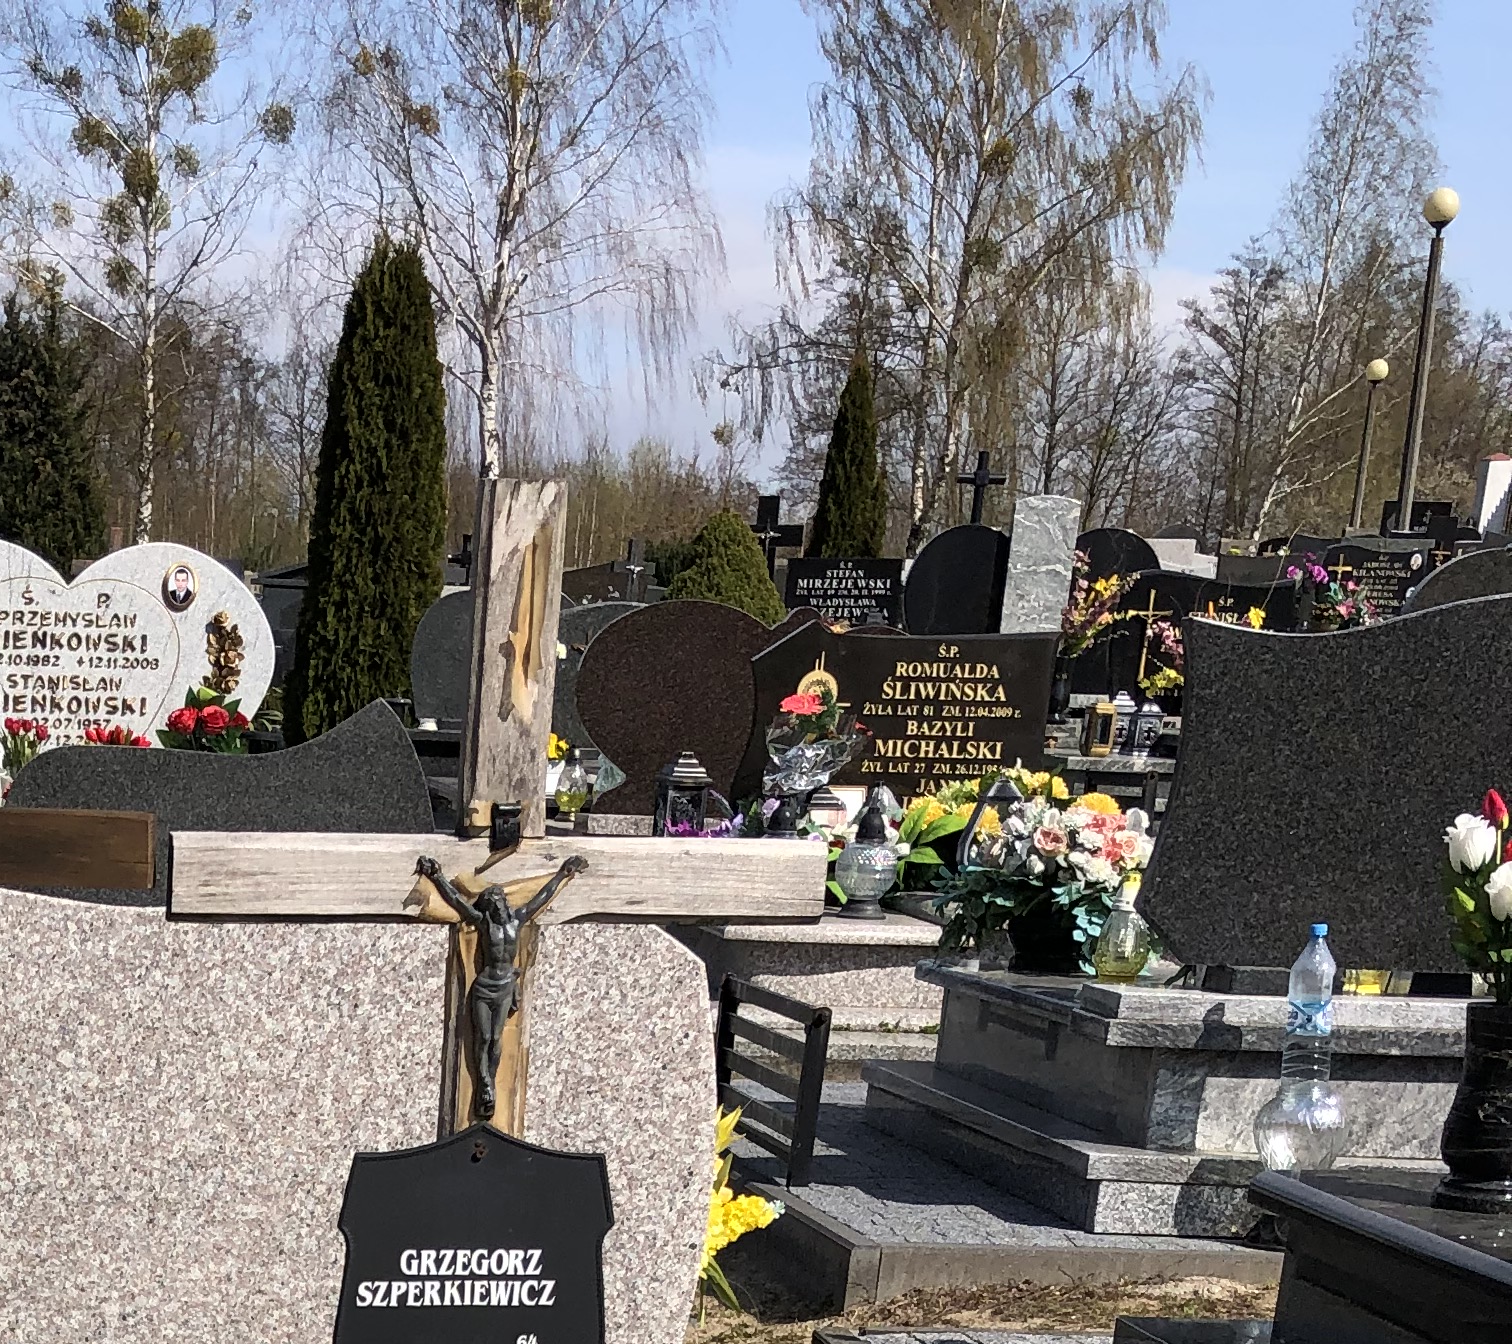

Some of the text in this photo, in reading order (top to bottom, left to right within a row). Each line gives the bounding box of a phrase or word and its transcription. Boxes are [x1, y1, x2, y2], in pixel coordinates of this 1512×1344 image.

[826, 569, 865, 578] STEFAN
[797, 578, 891, 589] MIRZEJEWSKI
[938, 643, 960, 658] Ś.P.
[895, 661, 1000, 679] ROMUALDA
[882, 676, 1007, 701] ŚLIWIŃSKA
[897, 705, 919, 716] LAT
[923, 706, 934, 716] 81
[906, 720, 975, 737] BAZYLI
[874, 739, 1003, 760] MICHALSKI
[888, 762, 910, 773] LAT
[914, 763, 925, 773] 27
[400, 1249, 543, 1276] GRZEGORZ
[356, 1280, 557, 1307] SZPERKIEWICZ
